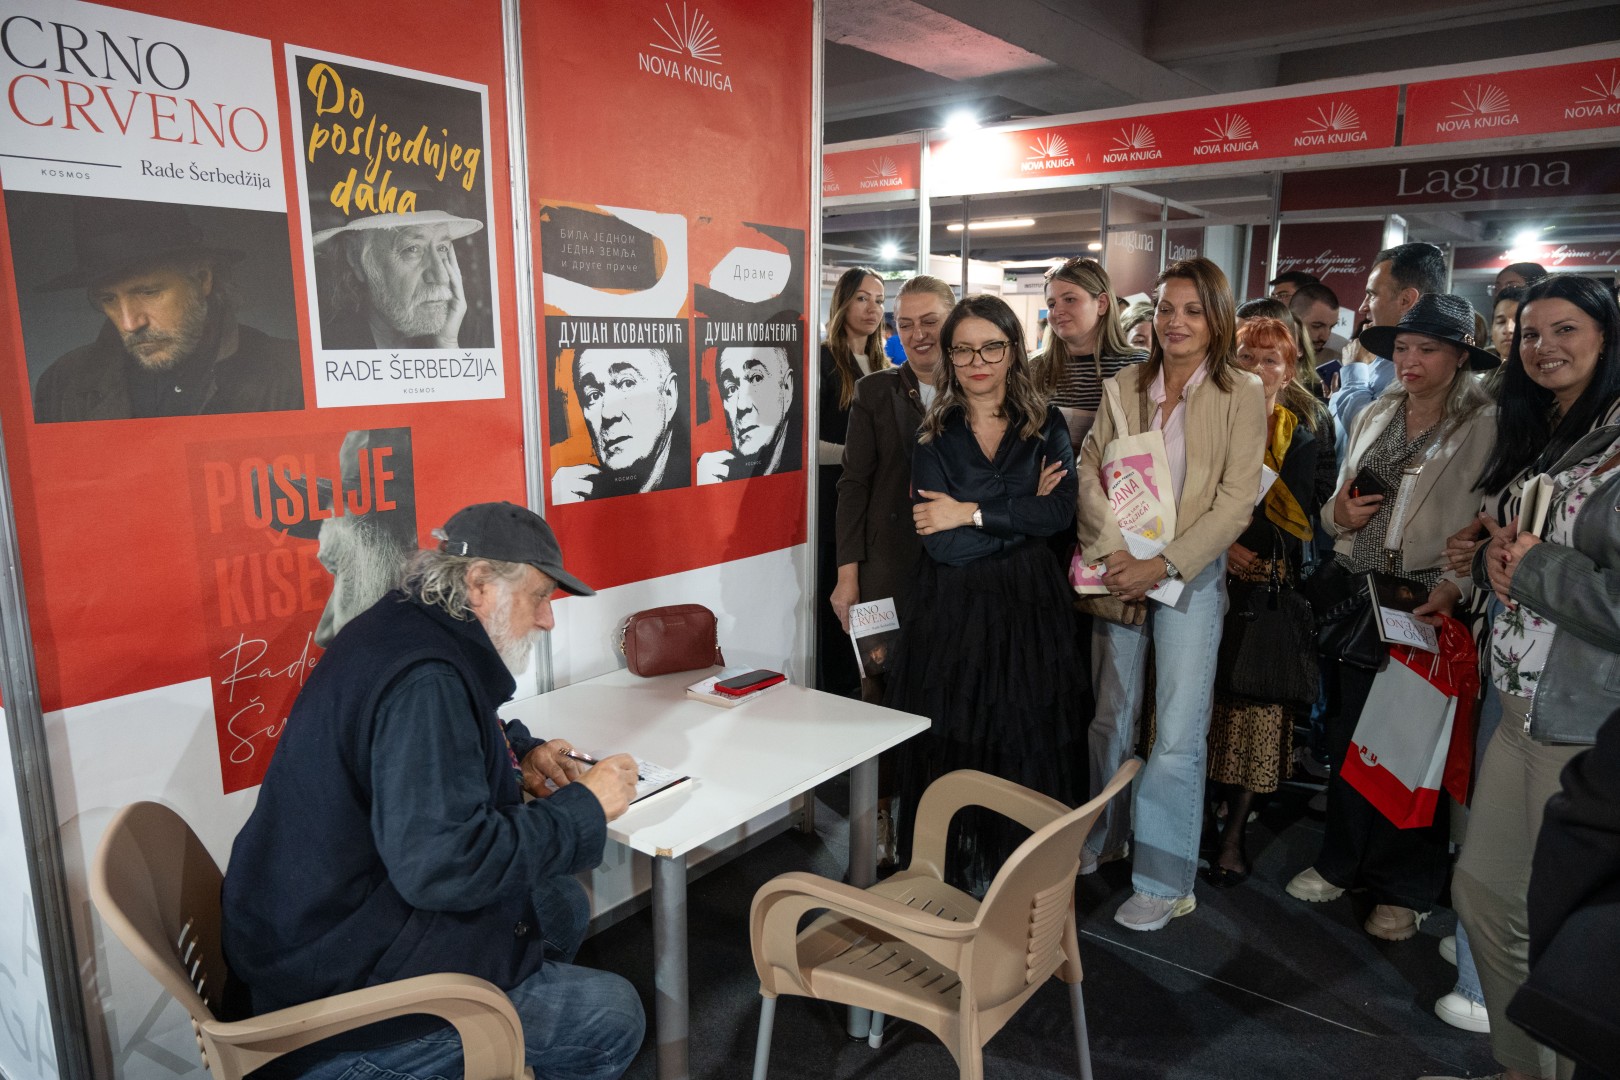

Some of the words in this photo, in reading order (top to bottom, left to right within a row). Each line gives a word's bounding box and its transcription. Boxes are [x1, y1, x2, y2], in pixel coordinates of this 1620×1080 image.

[1, 15, 191, 90] CRNO
[639, 52, 680, 80] NOVA
[685, 65, 733, 92] KNJIGA
[307, 62, 364, 119] Do
[7, 75, 269, 152] CRVENO
[1437, 121, 1471, 132] NOVA
[1474, 114, 1519, 128] KNJIGA
[1565, 106, 1603, 118] NOVA
[1193, 145, 1221, 156] NOVA
[1223, 141, 1259, 152] KNJIGA
[1294, 136, 1325, 147] NOVA
[1328, 131, 1367, 144] KNJIGA
[309, 114, 481, 191] posljednjeg
[1021, 162, 1044, 171] NOVA
[1046, 158, 1075, 168] KNJIGA
[1103, 154, 1128, 163] NOVA
[1130, 150, 1162, 161] KNJIGA
[41, 168, 91, 180] KOSMOS
[140, 160, 185, 180] Rade
[189, 163, 271, 190] Šerbedžija
[860, 180, 878, 188] NOVA
[880, 177, 903, 186] KNJIGA
[1396, 160, 1571, 199] Laguna
[330, 168, 417, 215] daha
[823, 183, 840, 192] NJIGA
[560, 228, 589, 240] БИЛА
[594, 232, 635, 244] ЈЕДНОМ
[561, 244, 595, 256] ЈЕДНА
[600, 246, 636, 258] ЗЕМЉА
[573, 261, 602, 271] друге
[606, 262, 639, 273] приче
[733, 264, 775, 281] Драме
[558, 321, 608, 348] ДУШАН
[613, 323, 683, 344] КОВАЧЕВИЋ
[704, 321, 744, 345] ДУШАН
[747, 322, 798, 342] КОВАЧЕВИЋ
[326, 358, 384, 383] RADE
[390, 353, 498, 381] ŠERBEDŽIJA
[202, 447, 397, 534] POSLIJE
[213, 529, 323, 628] KIŠE
[849, 604, 879, 619] CRNO
[219, 631, 320, 702] Rade
